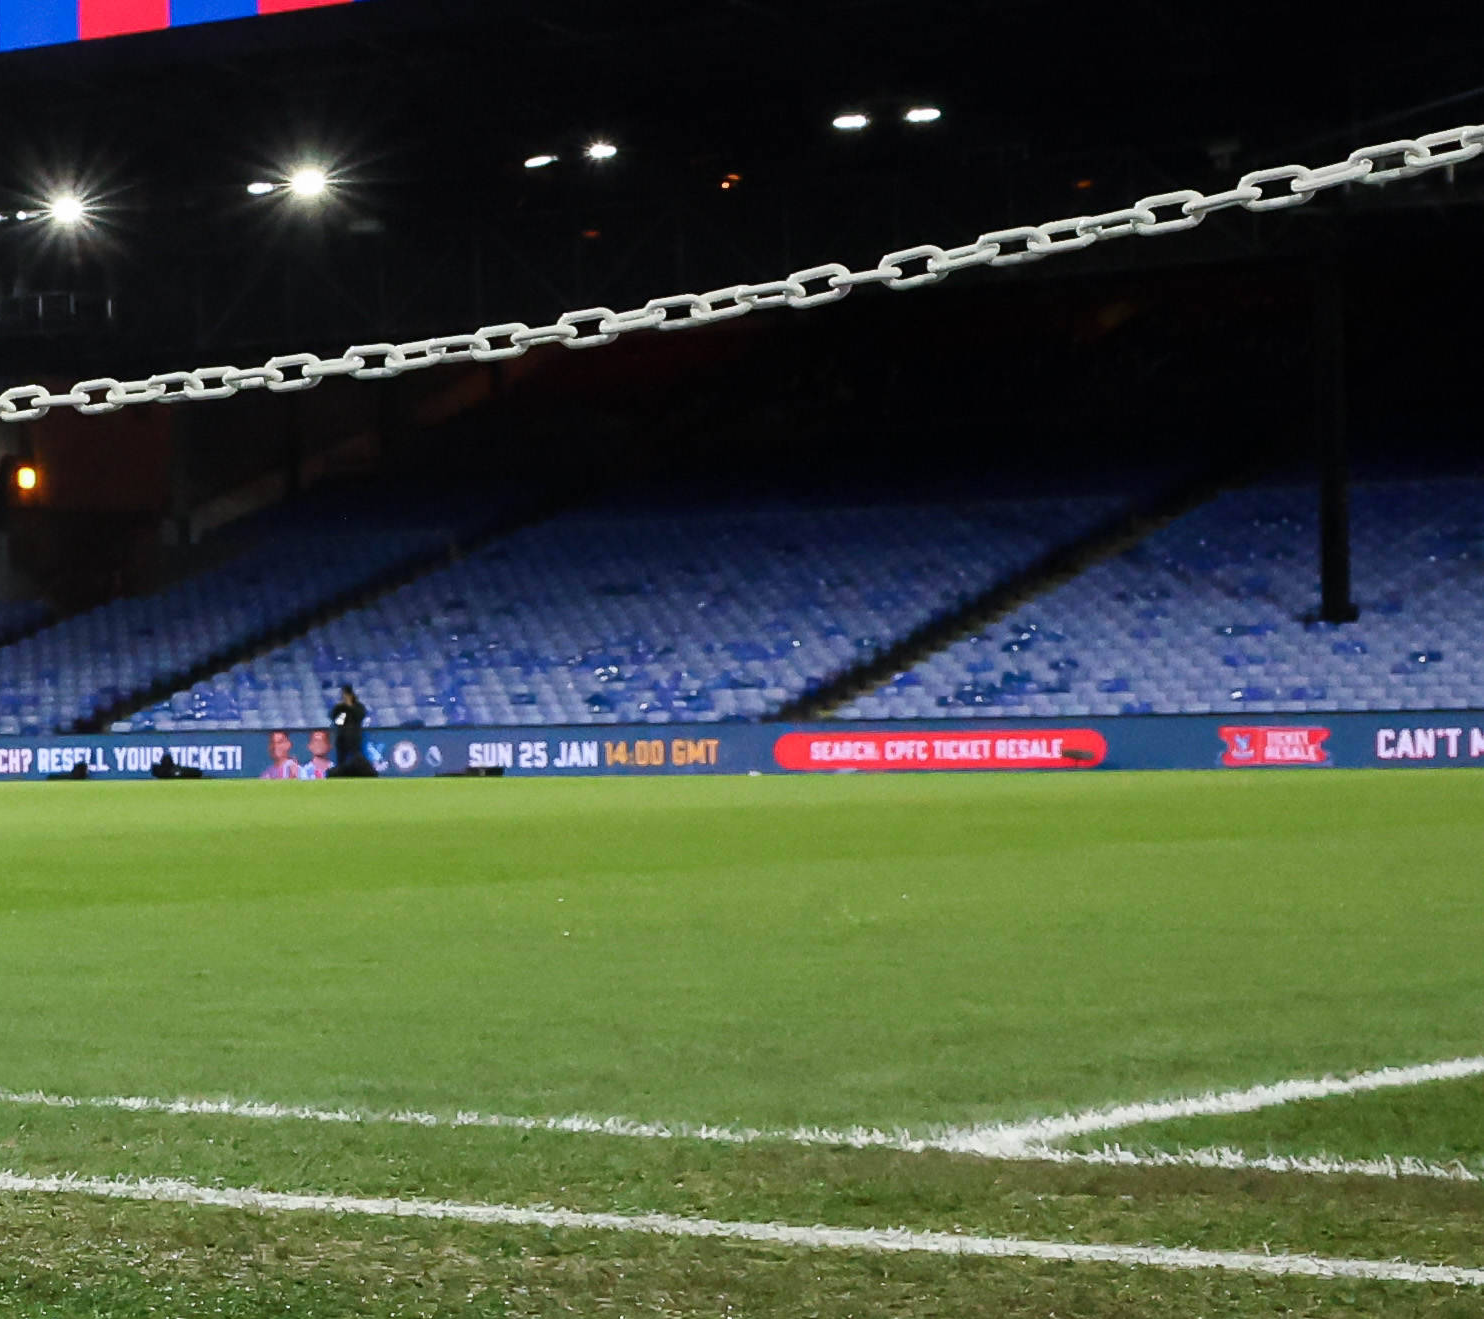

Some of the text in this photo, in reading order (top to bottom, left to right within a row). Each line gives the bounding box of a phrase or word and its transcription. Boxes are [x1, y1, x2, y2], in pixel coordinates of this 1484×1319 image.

[468, 742, 513, 768] SUN
[518, 741, 548, 768] 25
[553, 741, 599, 768] JAN
[671, 739, 719, 765] GMT
[1375, 727, 1463, 759] CAN'T
